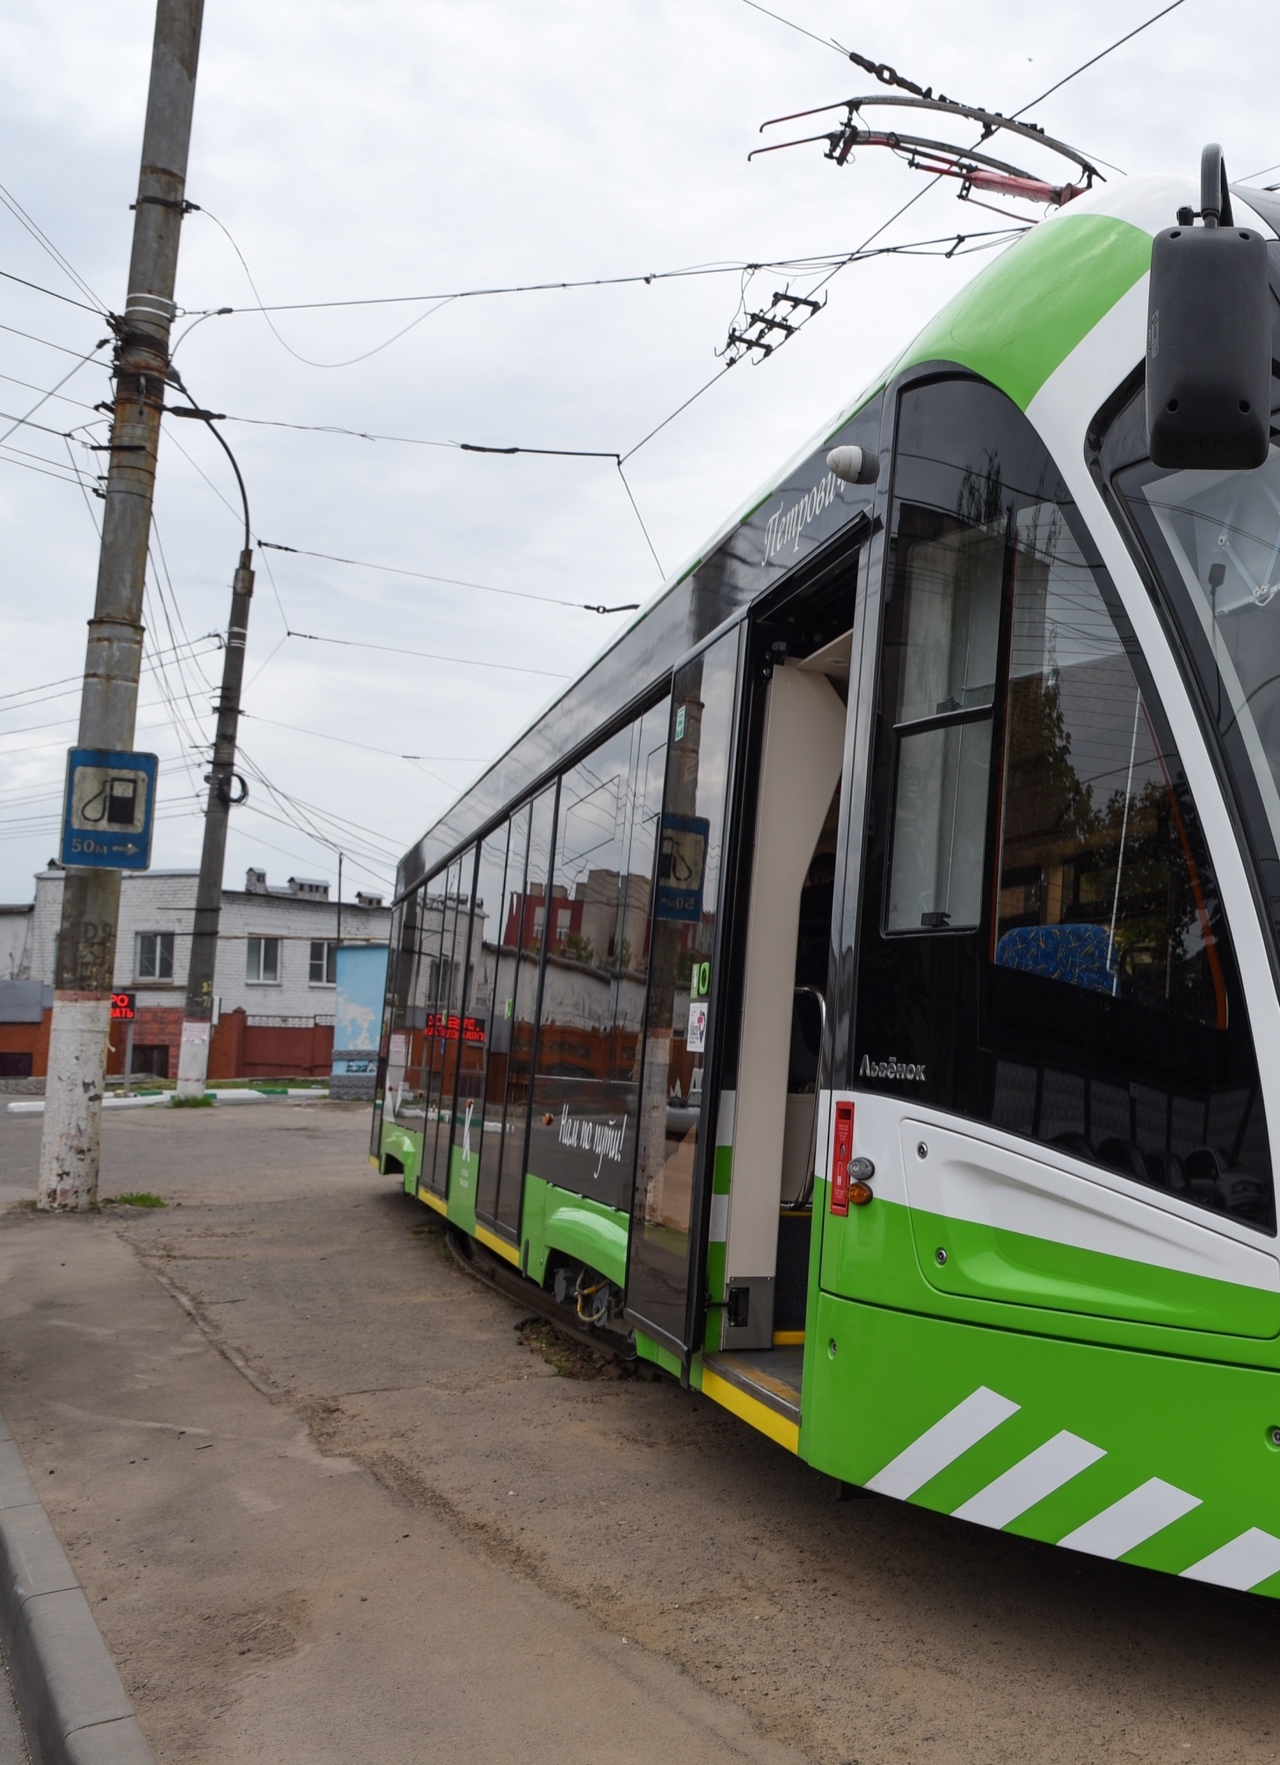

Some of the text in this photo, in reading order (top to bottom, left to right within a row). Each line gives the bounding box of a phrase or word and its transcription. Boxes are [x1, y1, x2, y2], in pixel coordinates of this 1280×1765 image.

[859, 1053, 926, 1082] Львёнок
[559, 1103, 580, 1148] Нам
[580, 1120, 593, 1150] по
